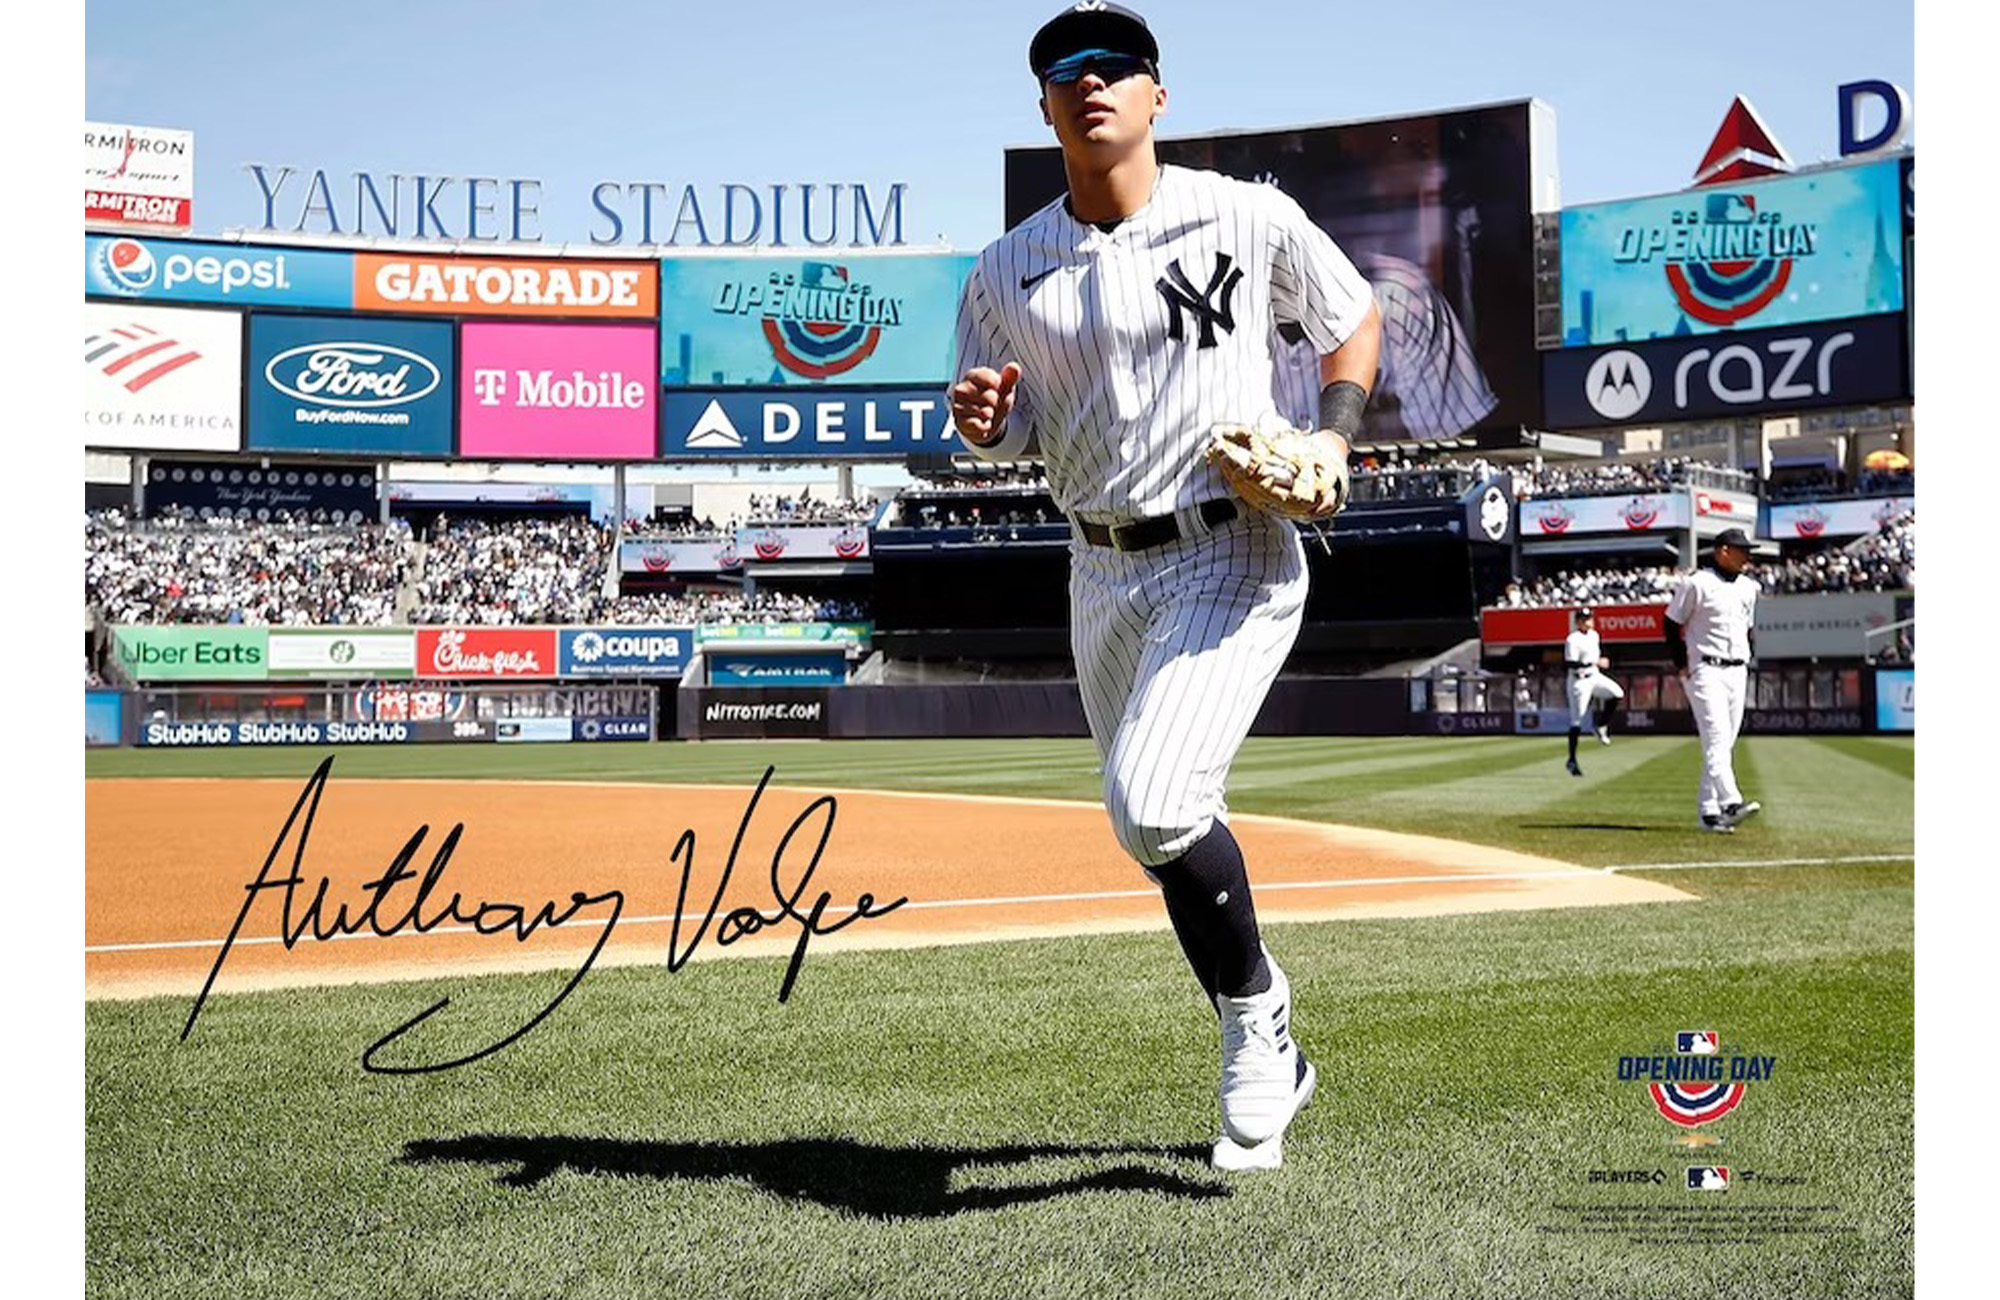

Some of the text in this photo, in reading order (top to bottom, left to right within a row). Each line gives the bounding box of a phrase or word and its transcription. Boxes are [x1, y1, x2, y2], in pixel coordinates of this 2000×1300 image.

[243, 164, 908, 247] YANKEE STADIUM
[1613, 223, 1816, 264] OPENING DAY
[375, 263, 639, 306] GATORADE
[713, 282, 902, 326] OPENING DAY
[1154, 251, 1244, 351] NY
[296, 350, 411, 397] Ford
[474, 369, 645, 408] T Mobile
[1674, 332, 1855, 408] razr
[98, 411, 124, 425] OF
[133, 412, 234, 429] AMERICA
[1599, 615, 1656, 630] TOYOTA
[121, 641, 188, 664] Uber
[195, 641, 261, 664] Eats
[606, 636, 680, 662] coupa
[148, 722, 408, 744] StubHub StubHub StubHub
[604, 723, 648, 735] CLEAR
[181, 755, 624, 1074] Anthony
